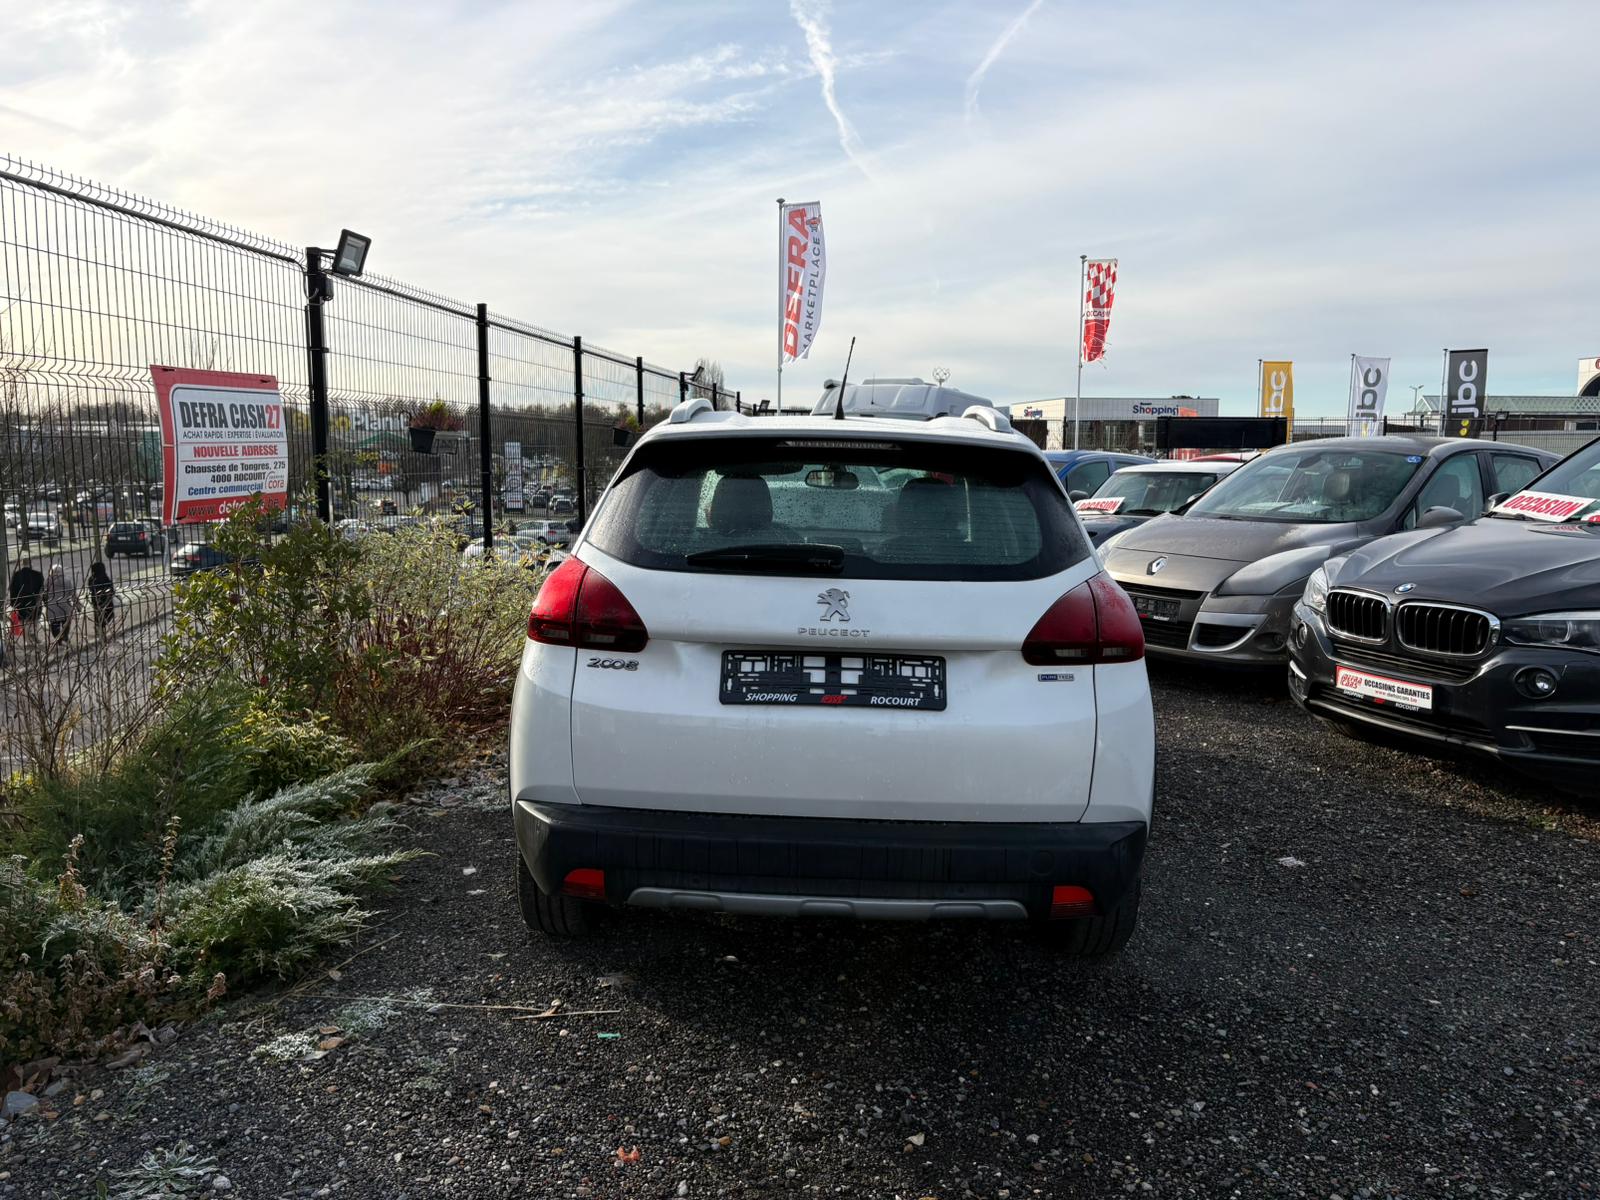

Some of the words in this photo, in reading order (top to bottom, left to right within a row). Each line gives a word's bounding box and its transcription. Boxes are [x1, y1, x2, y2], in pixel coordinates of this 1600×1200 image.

[784, 207, 809, 359] DEFRA
[1265, 370, 1287, 417] bc
[1355, 366, 1382, 422] jbc
[1451, 359, 1479, 418] jbc
[178, 401, 229, 429] DEFRA
[229, 403, 281, 430] CASH27
[1132, 404, 1179, 416] Shopping
[182, 430, 203, 439] ACHAT
[203, 430, 224, 439] RAPIDE
[227, 430, 252, 439] EXPERTISE
[192, 445, 240, 458] NOUVELLE
[241, 444, 279, 457] ADRESSE
[184, 463, 227, 475] Chaussée
[228, 462, 239, 473] de
[240, 462, 272, 475] Tongres,
[273, 460, 286, 470] 275
[210, 473, 232, 484] 4000
[233, 471, 266, 482] ROCOURT
[268, 479, 285, 490] cora
[187, 485, 217, 496] Centre
[218, 480, 264, 494] commercial
[1503, 494, 1584, 517] OCCASION
[797, 627, 871, 638] PEUGEOT
[587, 657, 640, 672] 2008
[1364, 679, 1396, 693] OCCASIONS
[1396, 686, 1430, 700] GARANTIES
[745, 692, 799, 703] SHOPPING
[870, 696, 921, 706] ROCOURT
[1395, 703, 1419, 712] ROCOURT
